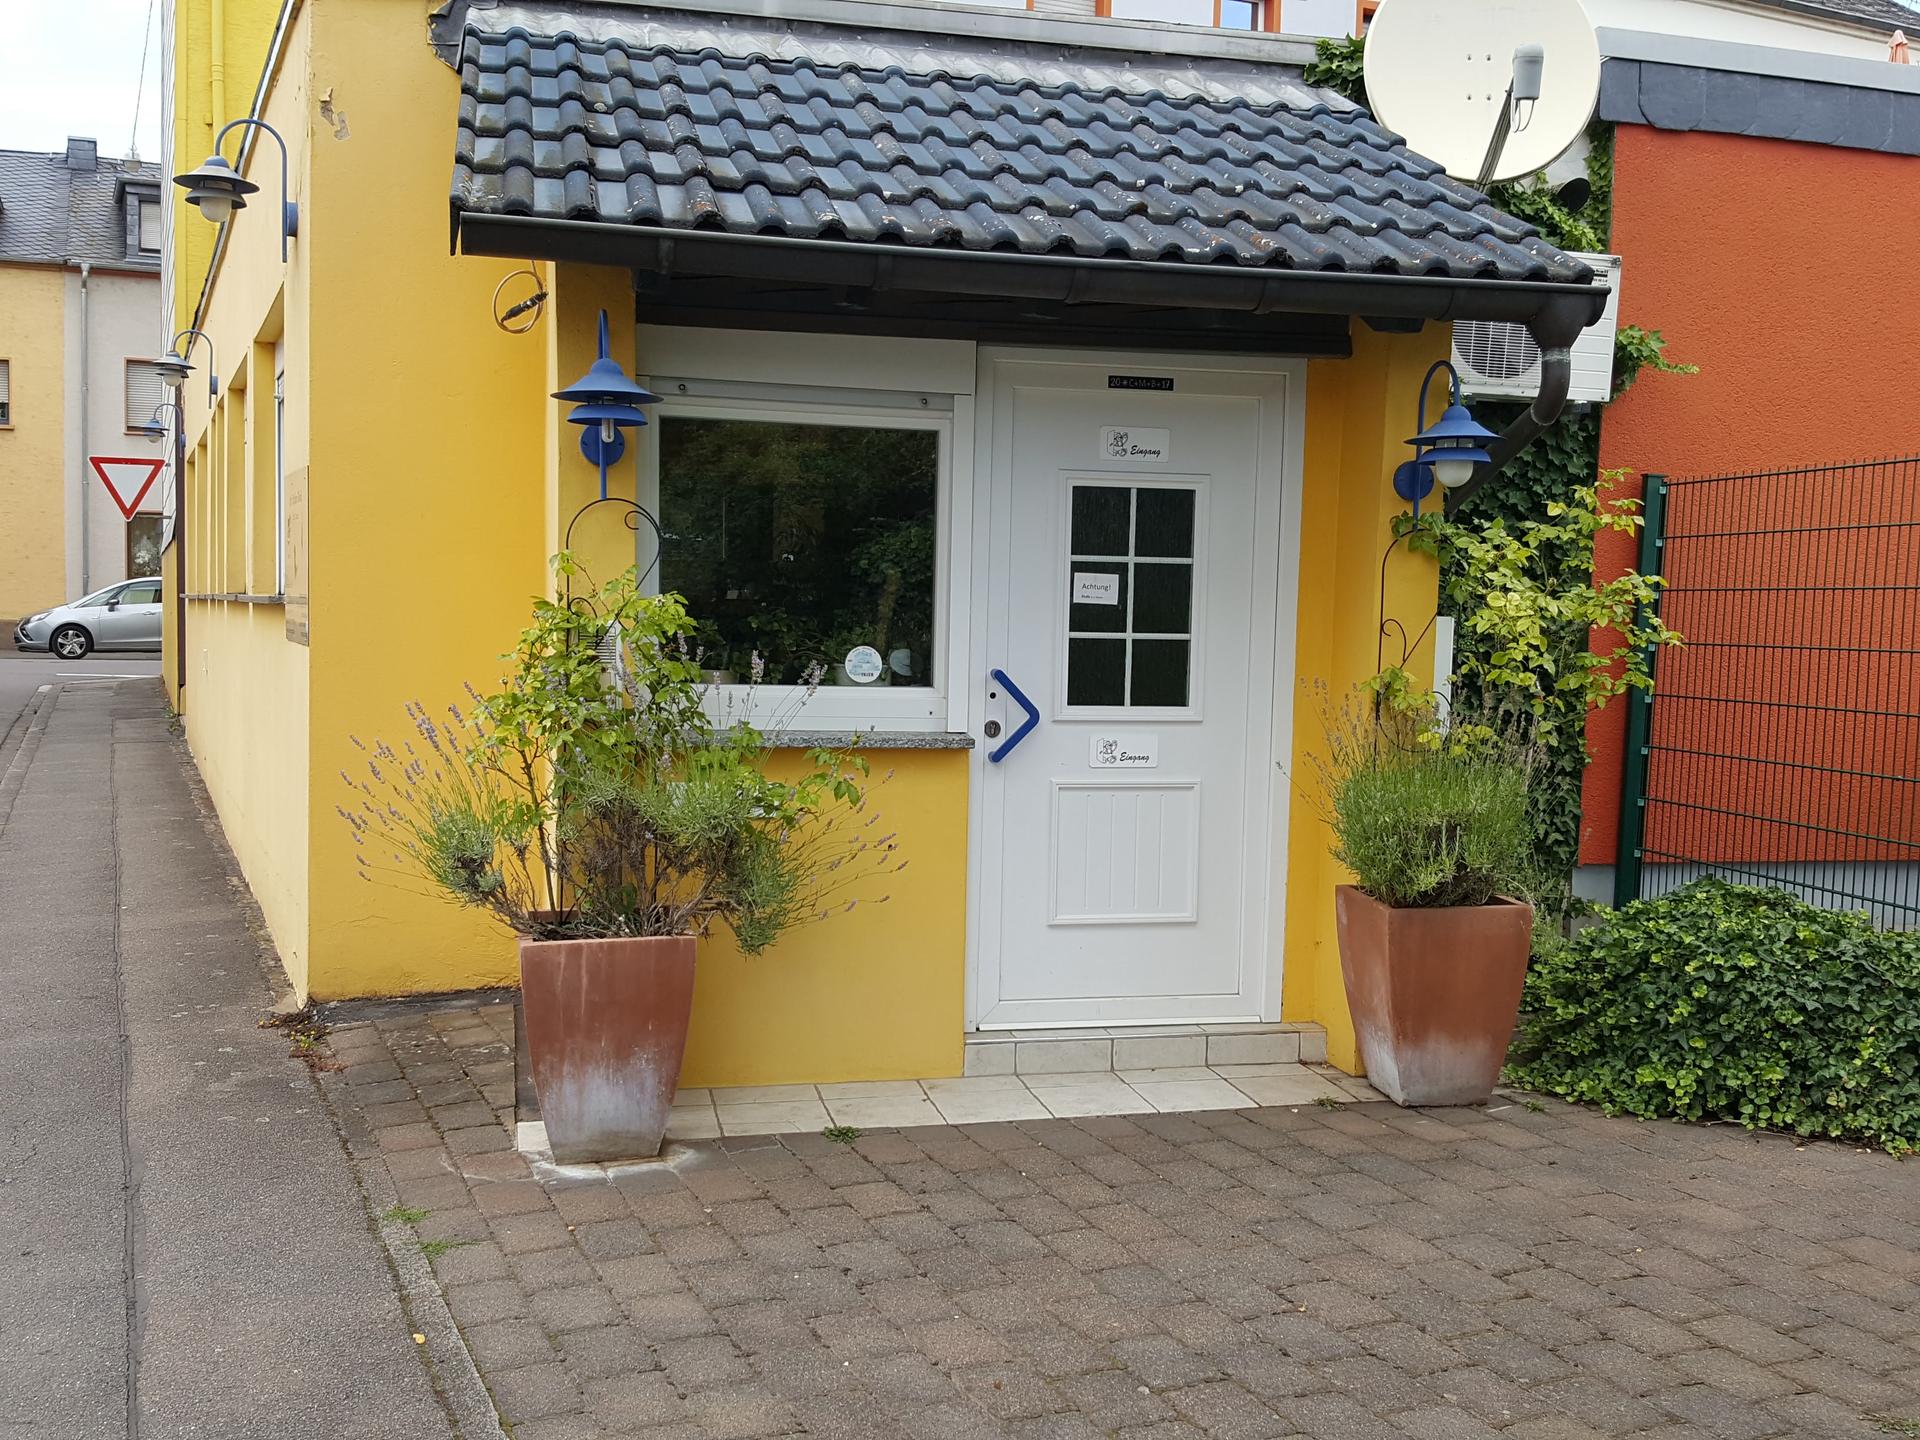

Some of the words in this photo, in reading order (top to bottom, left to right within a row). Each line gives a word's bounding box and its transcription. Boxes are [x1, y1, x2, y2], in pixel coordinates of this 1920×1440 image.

[1130, 445, 1161, 458] Eingang
[1081, 583, 1112, 592] Achtung!
[1119, 751, 1150, 764] Eingang
